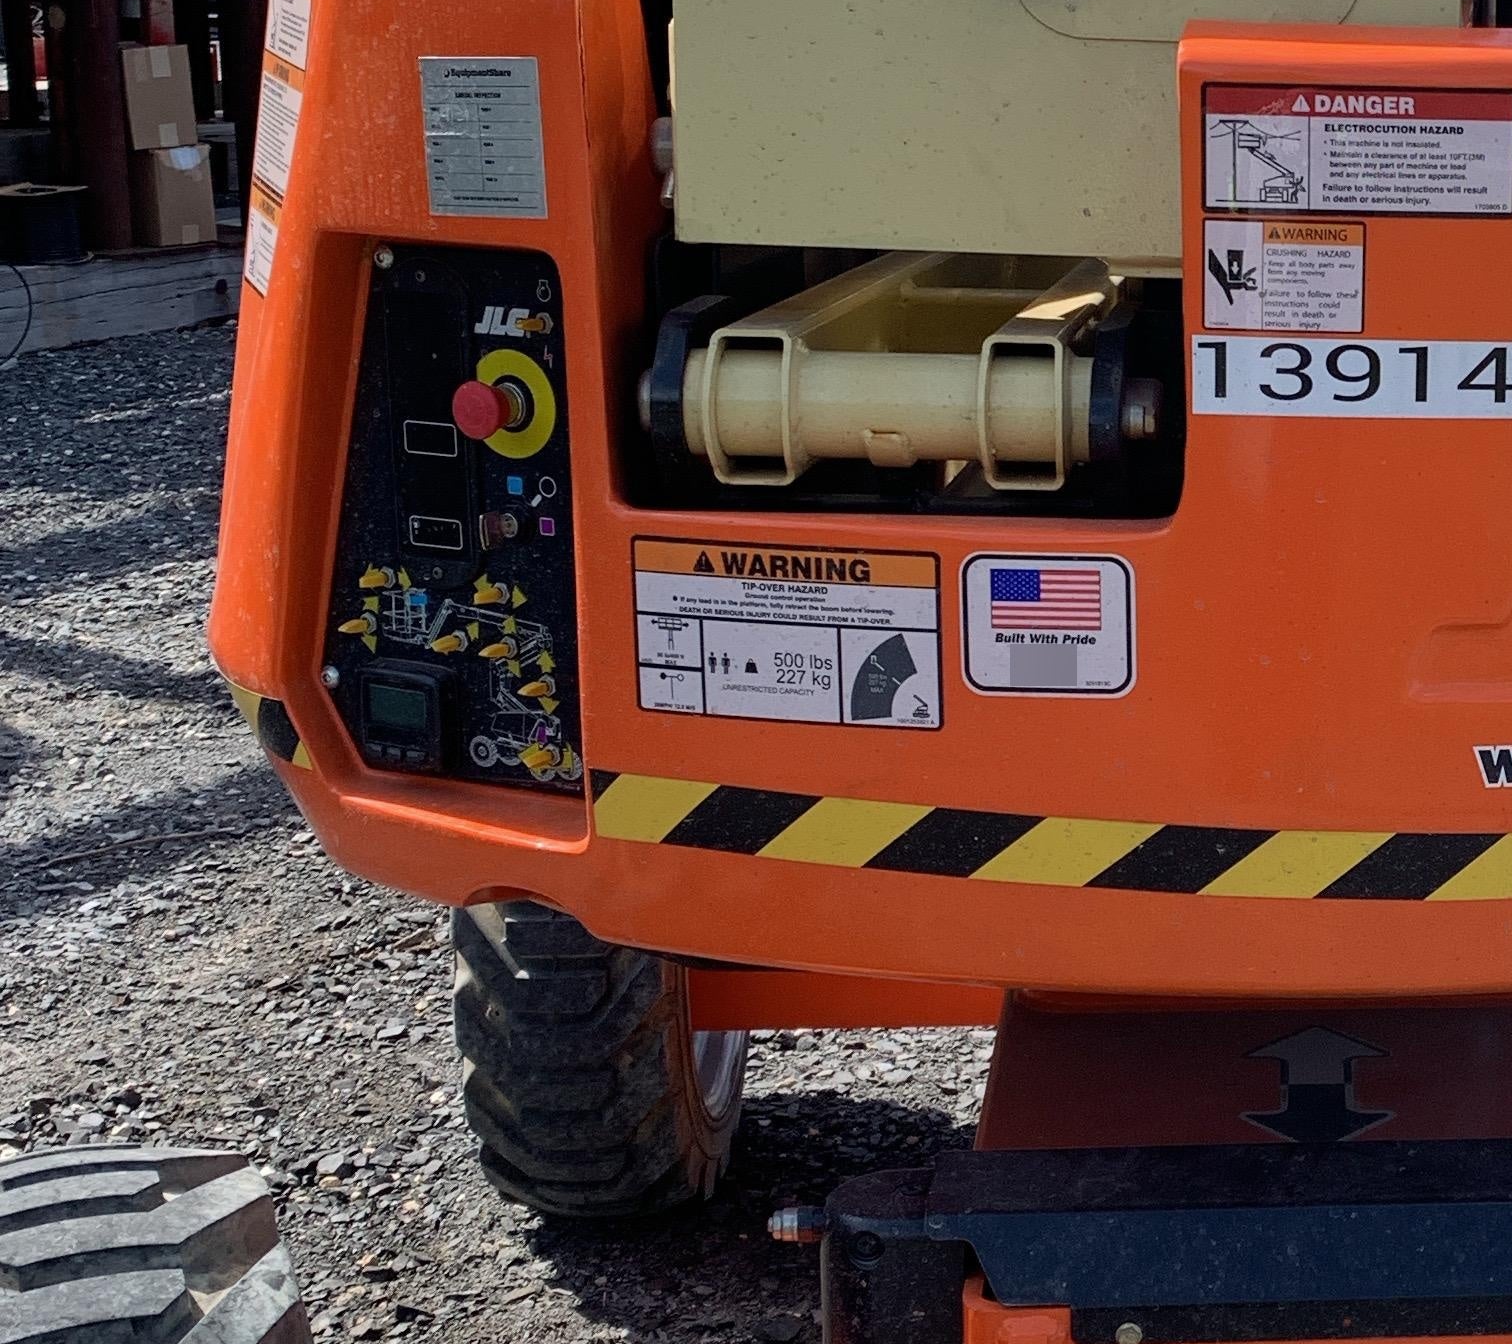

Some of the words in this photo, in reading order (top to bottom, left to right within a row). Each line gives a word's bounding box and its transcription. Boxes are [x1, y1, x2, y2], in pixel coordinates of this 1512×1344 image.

[1314, 95, 1415, 115] DANGER
[1324, 124, 1416, 134] ELECTROCUTION
[1420, 126, 1464, 135] HAZARD
[1330, 139, 1346, 147] This
[1348, 140, 1380, 148] machine
[1383, 140, 1389, 148] is
[1330, 151, 1362, 159] Maintain
[1379, 162, 1395, 170] part
[1346, 172, 1360, 180] any
[1429, 173, 1467, 181] apparatus.
[1323, 184, 1352, 192] Failure
[1366, 184, 1391, 193] follow
[1394, 185, 1444, 194] instructions
[1447, 186, 1461, 194] will
[1333, 195, 1357, 203] death
[1371, 196, 1402, 204] serious
[1406, 197, 1431, 206] injury.
[1282, 228, 1348, 242] WARNING
[1266, 249, 1307, 257] CRUSHING
[1308, 290, 1332, 298] follow
[721, 551, 871, 583] WARNING
[741, 582, 785, 592] TIP-OVER
[788, 585, 828, 594] HAZARD
[995, 633, 1024, 644] Built
[1029, 634, 1058, 644] With
[1062, 634, 1097, 645] Pride
[774, 652, 803, 668] 500
[810, 654, 832, 670] lbs
[776, 669, 806, 684] 227
[812, 670, 831, 690] kg
[722, 684, 777, 694] UNRESTRICTED
[779, 687, 815, 696] CAPACITY
